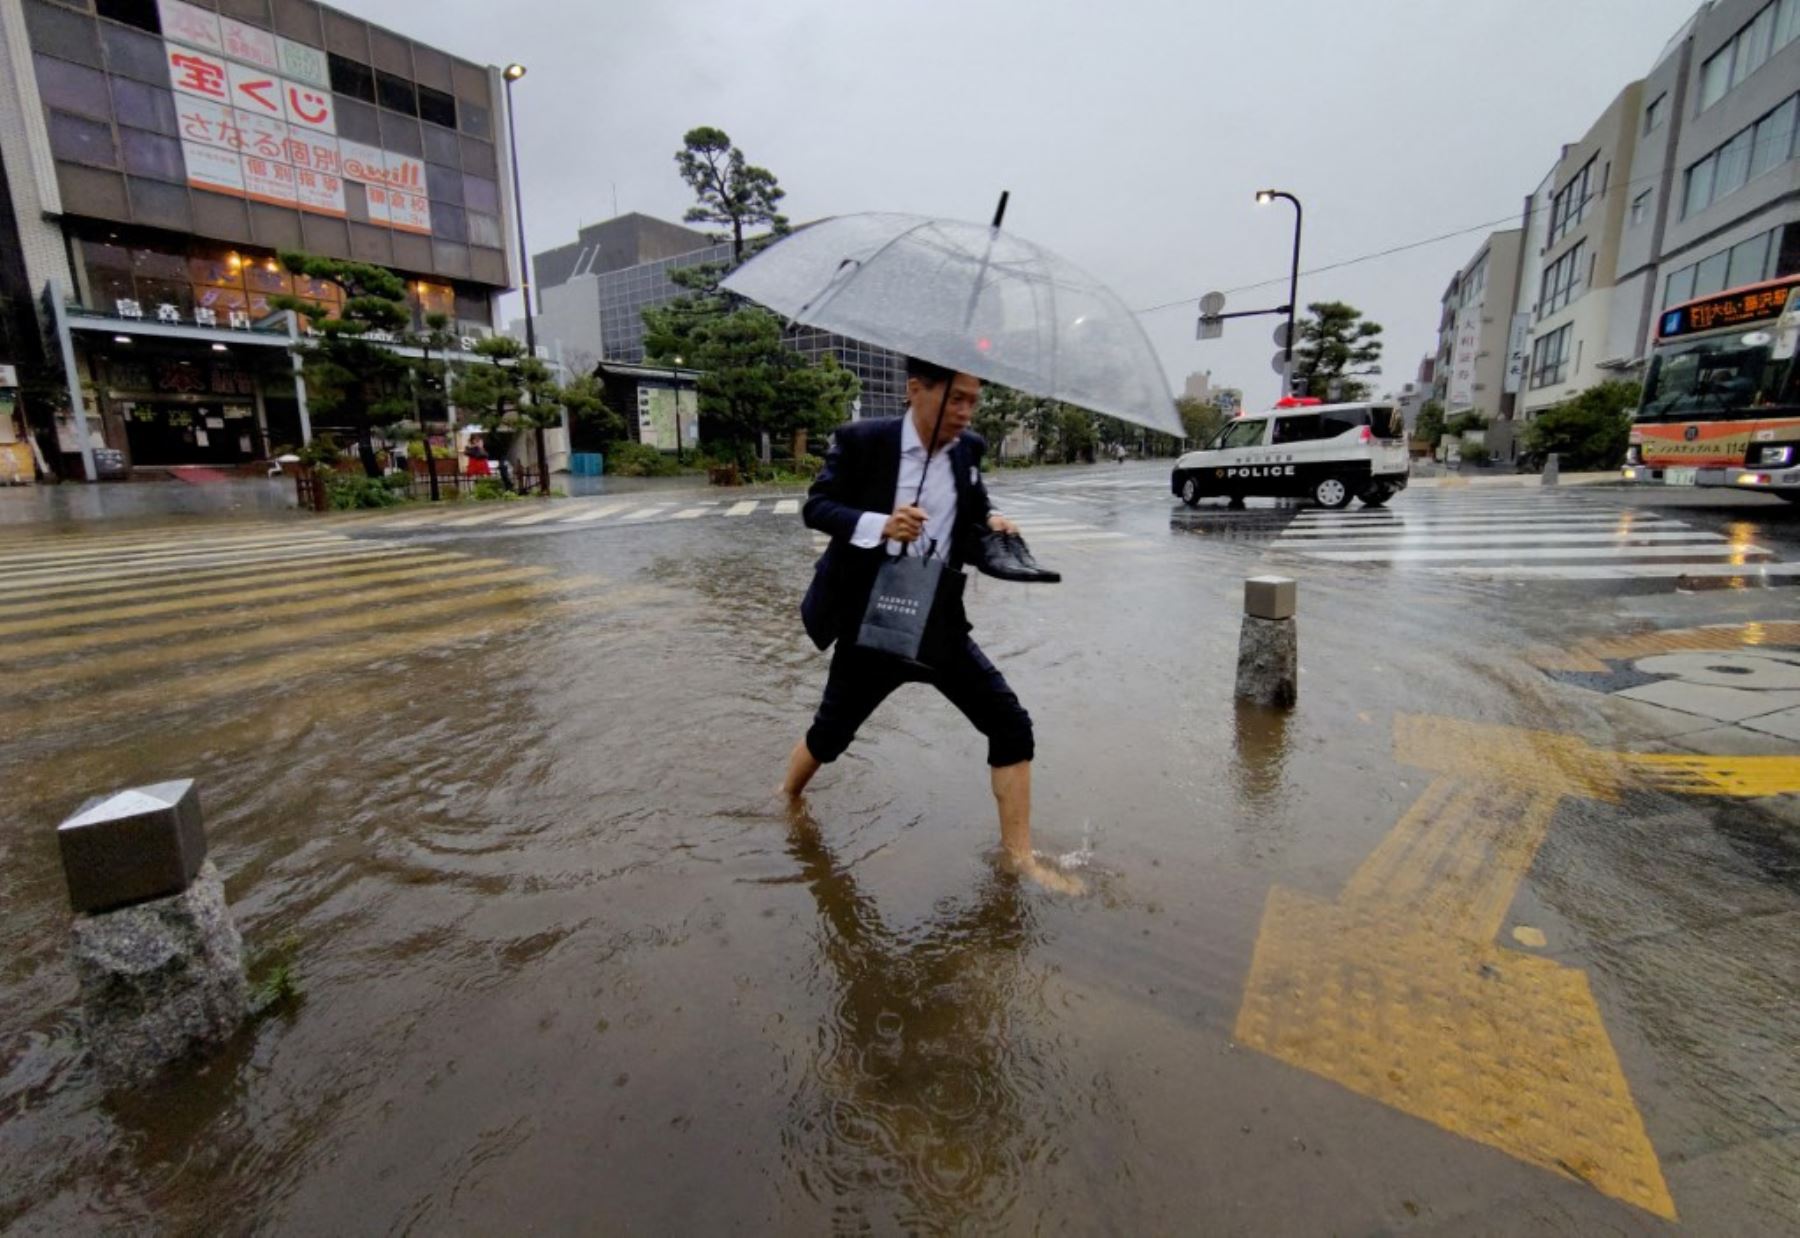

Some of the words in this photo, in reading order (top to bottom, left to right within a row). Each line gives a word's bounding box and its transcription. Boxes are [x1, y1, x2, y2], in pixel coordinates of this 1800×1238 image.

[171, 53, 328, 123] 宝くじ
[1227, 465, 1295, 478] POLICE
